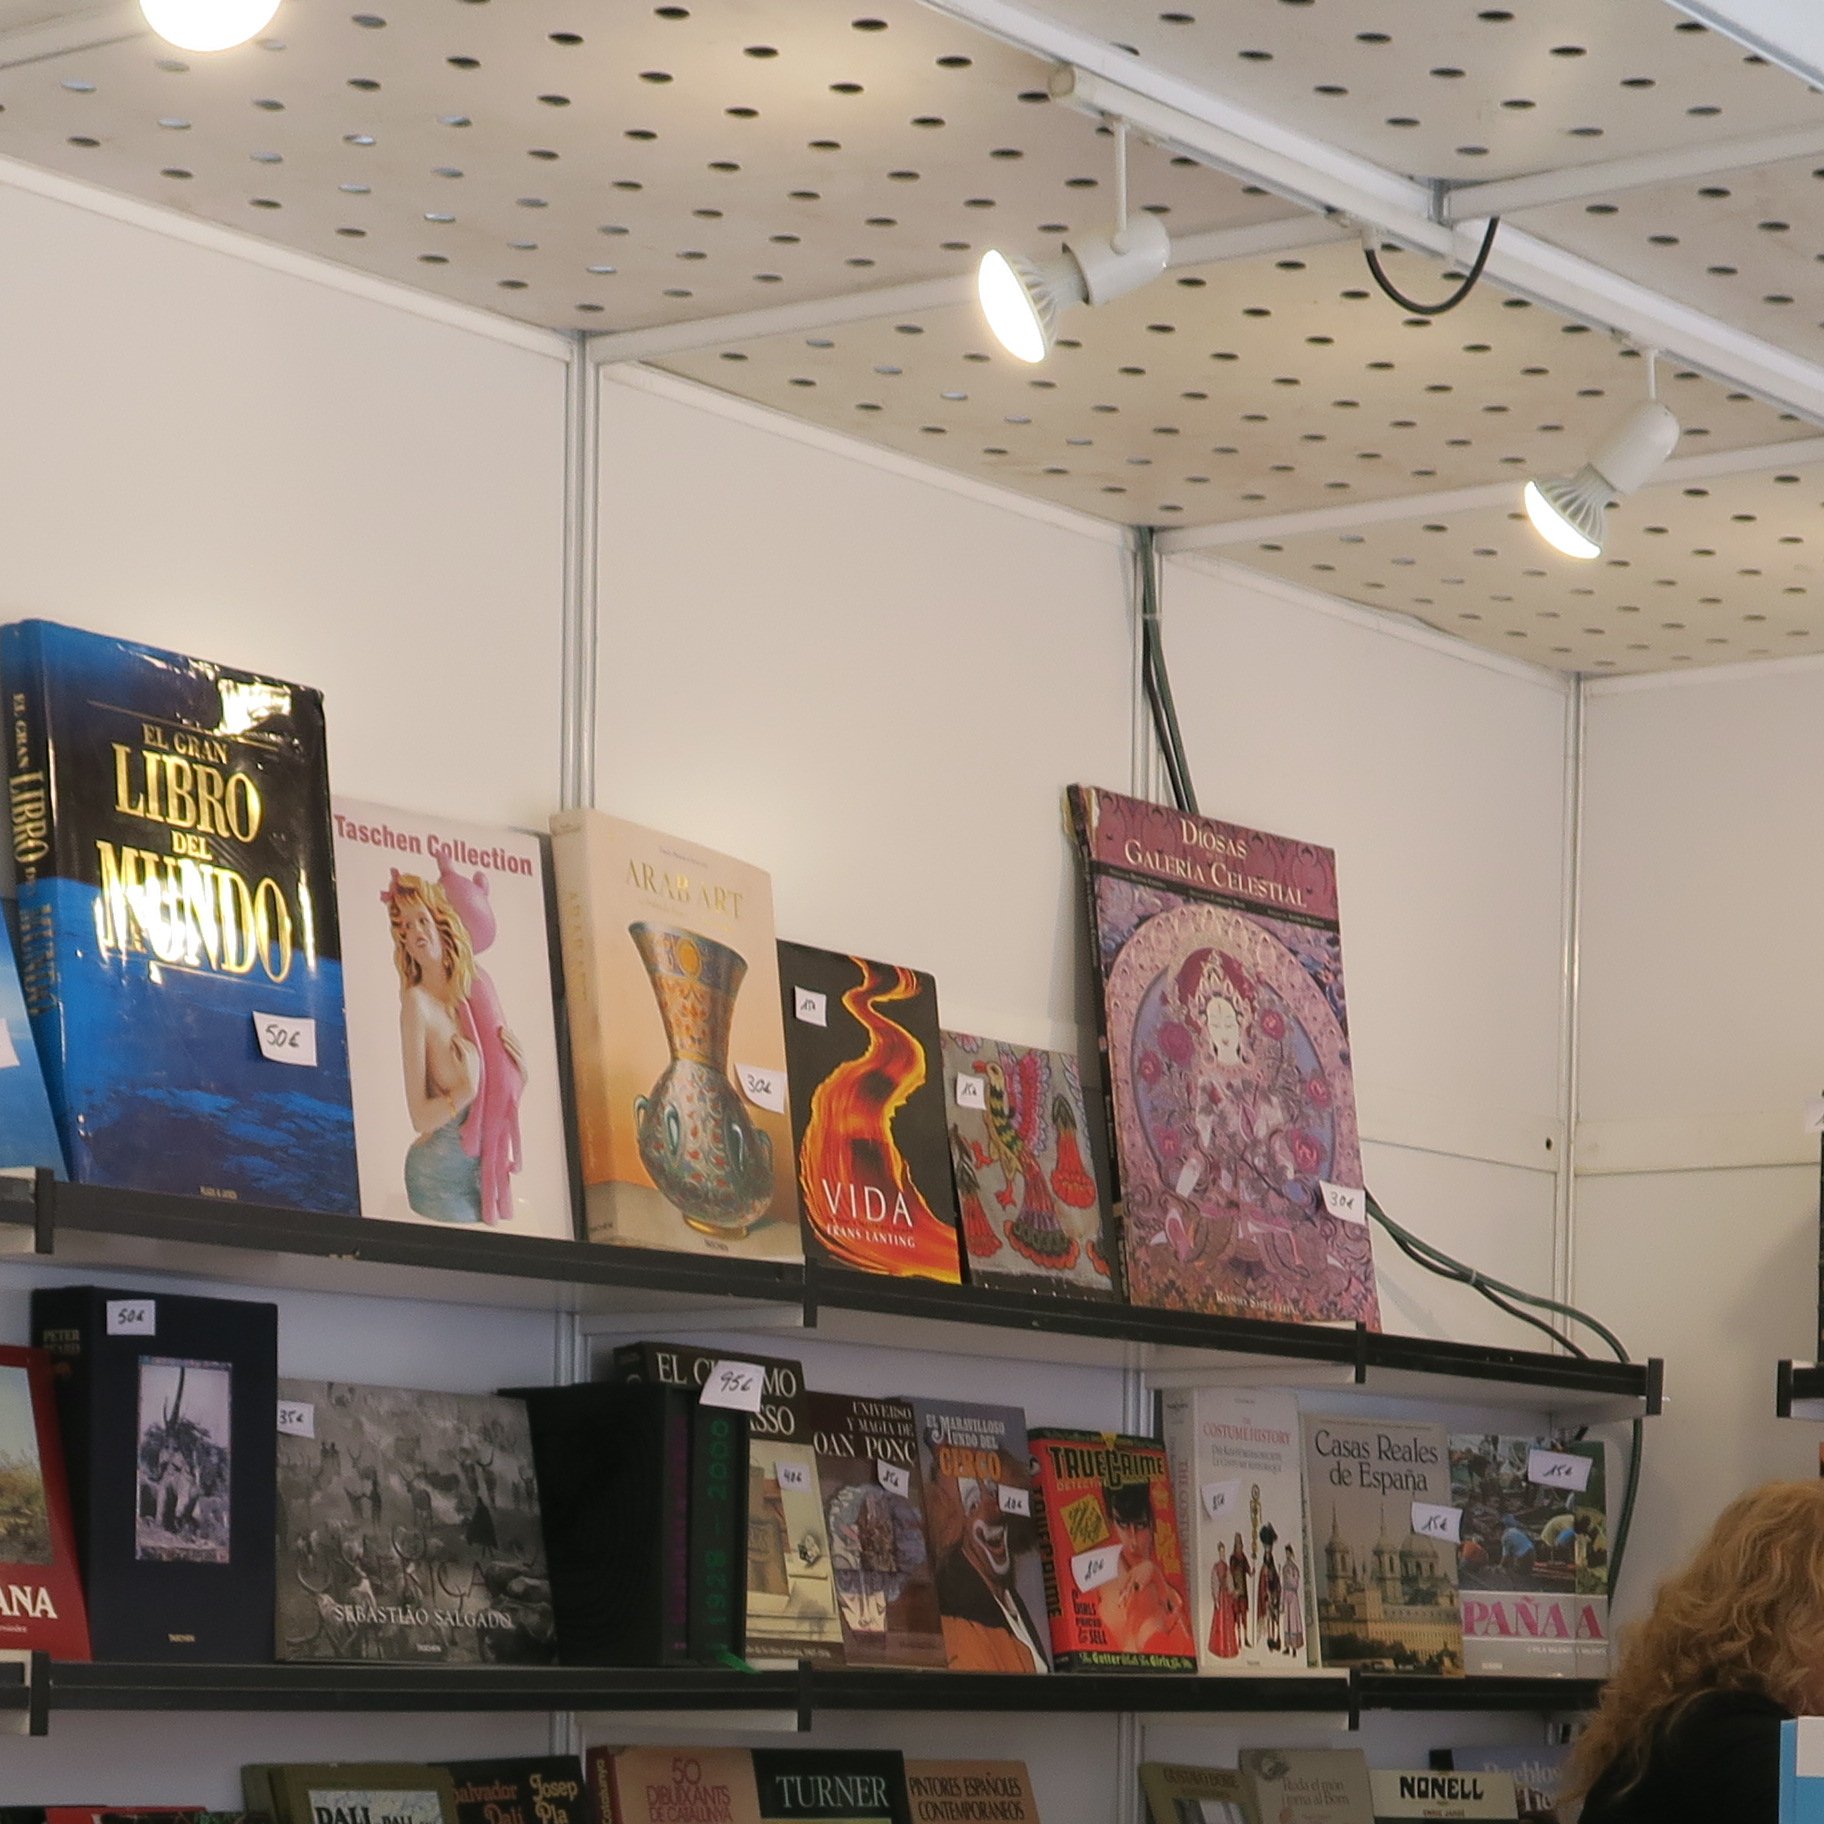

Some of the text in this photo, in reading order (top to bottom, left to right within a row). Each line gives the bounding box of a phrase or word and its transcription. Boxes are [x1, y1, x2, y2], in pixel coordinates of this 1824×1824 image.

[141, 722, 228, 766] EL GRAN
[112, 742, 262, 845] LIBRO
[171, 831, 213, 861] DEL
[334, 812, 534, 878] Taschen Collection
[625, 856, 745, 921] ARAB ART
[93, 840, 293, 984] MUNDO
[821, 1177, 914, 1229] VIDA
[720, 1371, 753, 1393] 95€
[1314, 1429, 1440, 1466] Casas Reales
[1049, 1445, 1166, 1488] TRUE CRIME
[1328, 1460, 1429, 1494] de España
[431, 1604, 514, 1631] SALGADO
[528, 1772, 578, 1803] Josep
[776, 1776, 891, 1809] TURNER
[1399, 1775, 1485, 1800] NONELL
